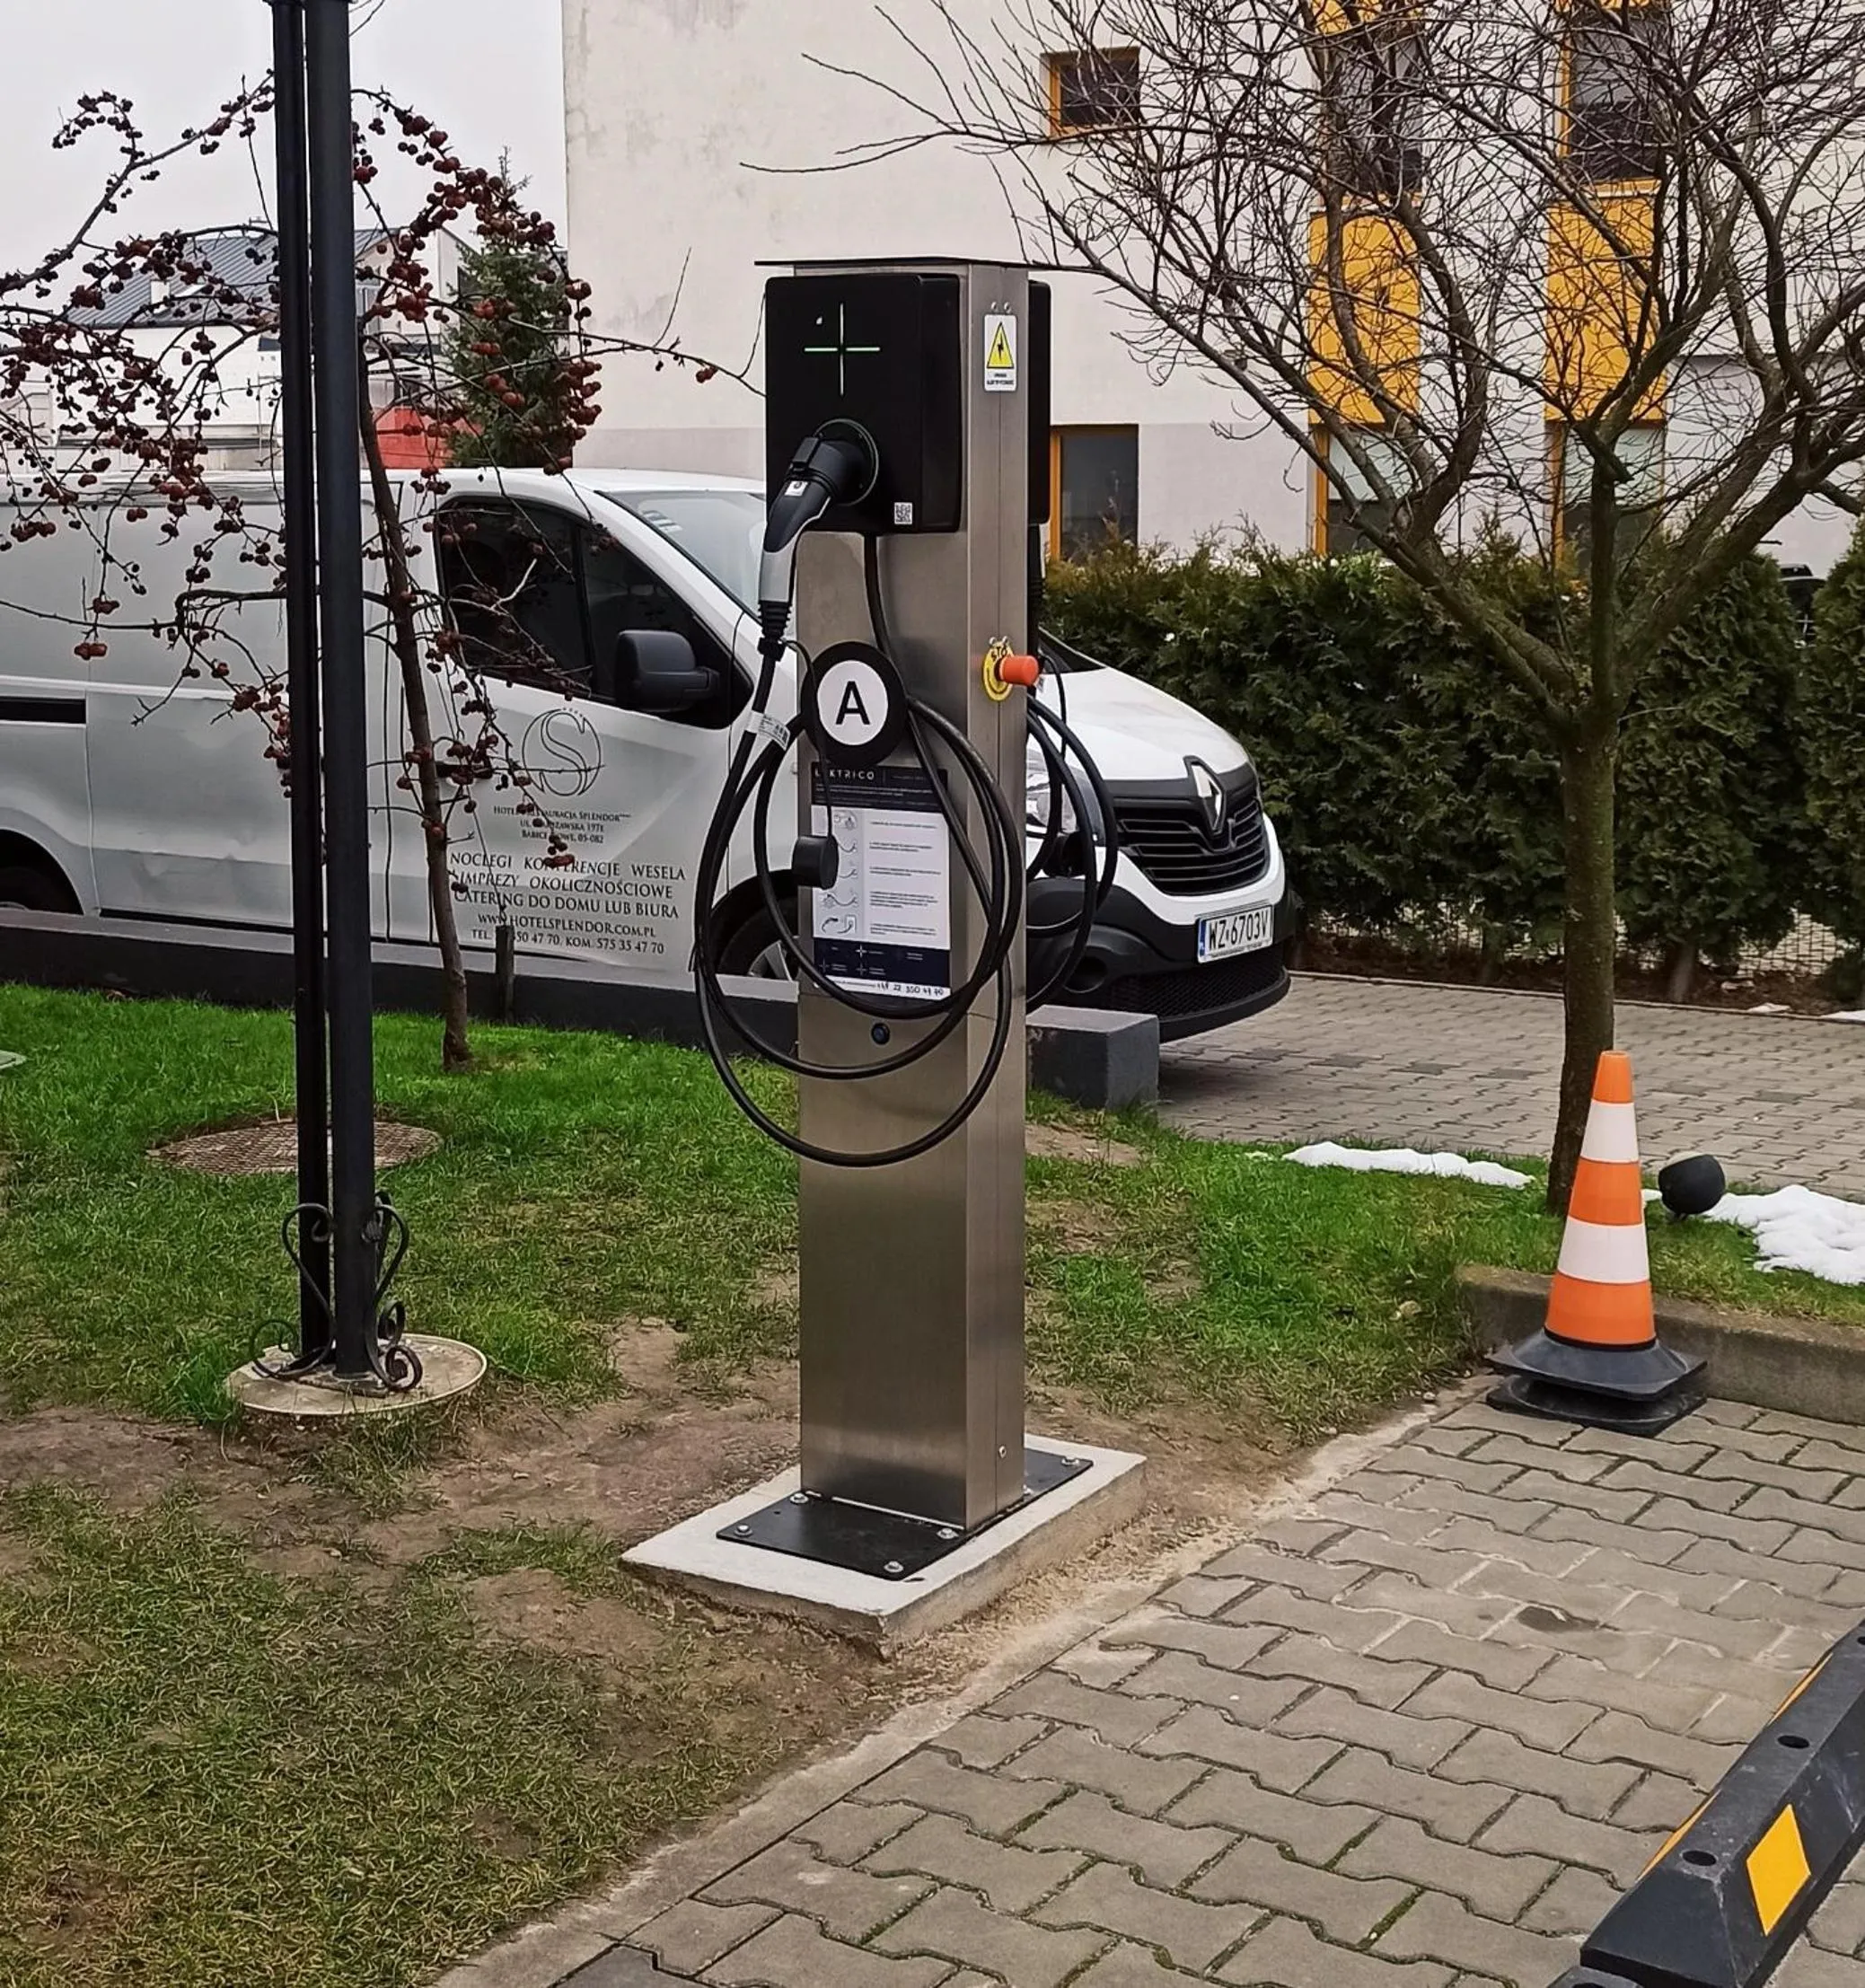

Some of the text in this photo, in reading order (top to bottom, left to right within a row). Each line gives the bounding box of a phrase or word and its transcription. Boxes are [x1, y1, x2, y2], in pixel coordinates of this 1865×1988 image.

[835, 681, 870, 726] A
[814, 769, 875, 780] LKTRICO
[451, 852, 512, 868] NOCLEGI
[631, 864, 685, 881] WESELA
[461, 871, 673, 899] IMPREZY OKOLICZNOŚCIOWE
[454, 887, 679, 919] CATERING DO DOMU LUB BIURA
[1230, 909, 1269, 946] 6703V
[532, 932, 544, 944] 47
[596, 937, 617, 950] 575
[619, 939, 631, 952] 35
[635, 941, 647, 953] 47
[651, 942, 664, 954] 70
